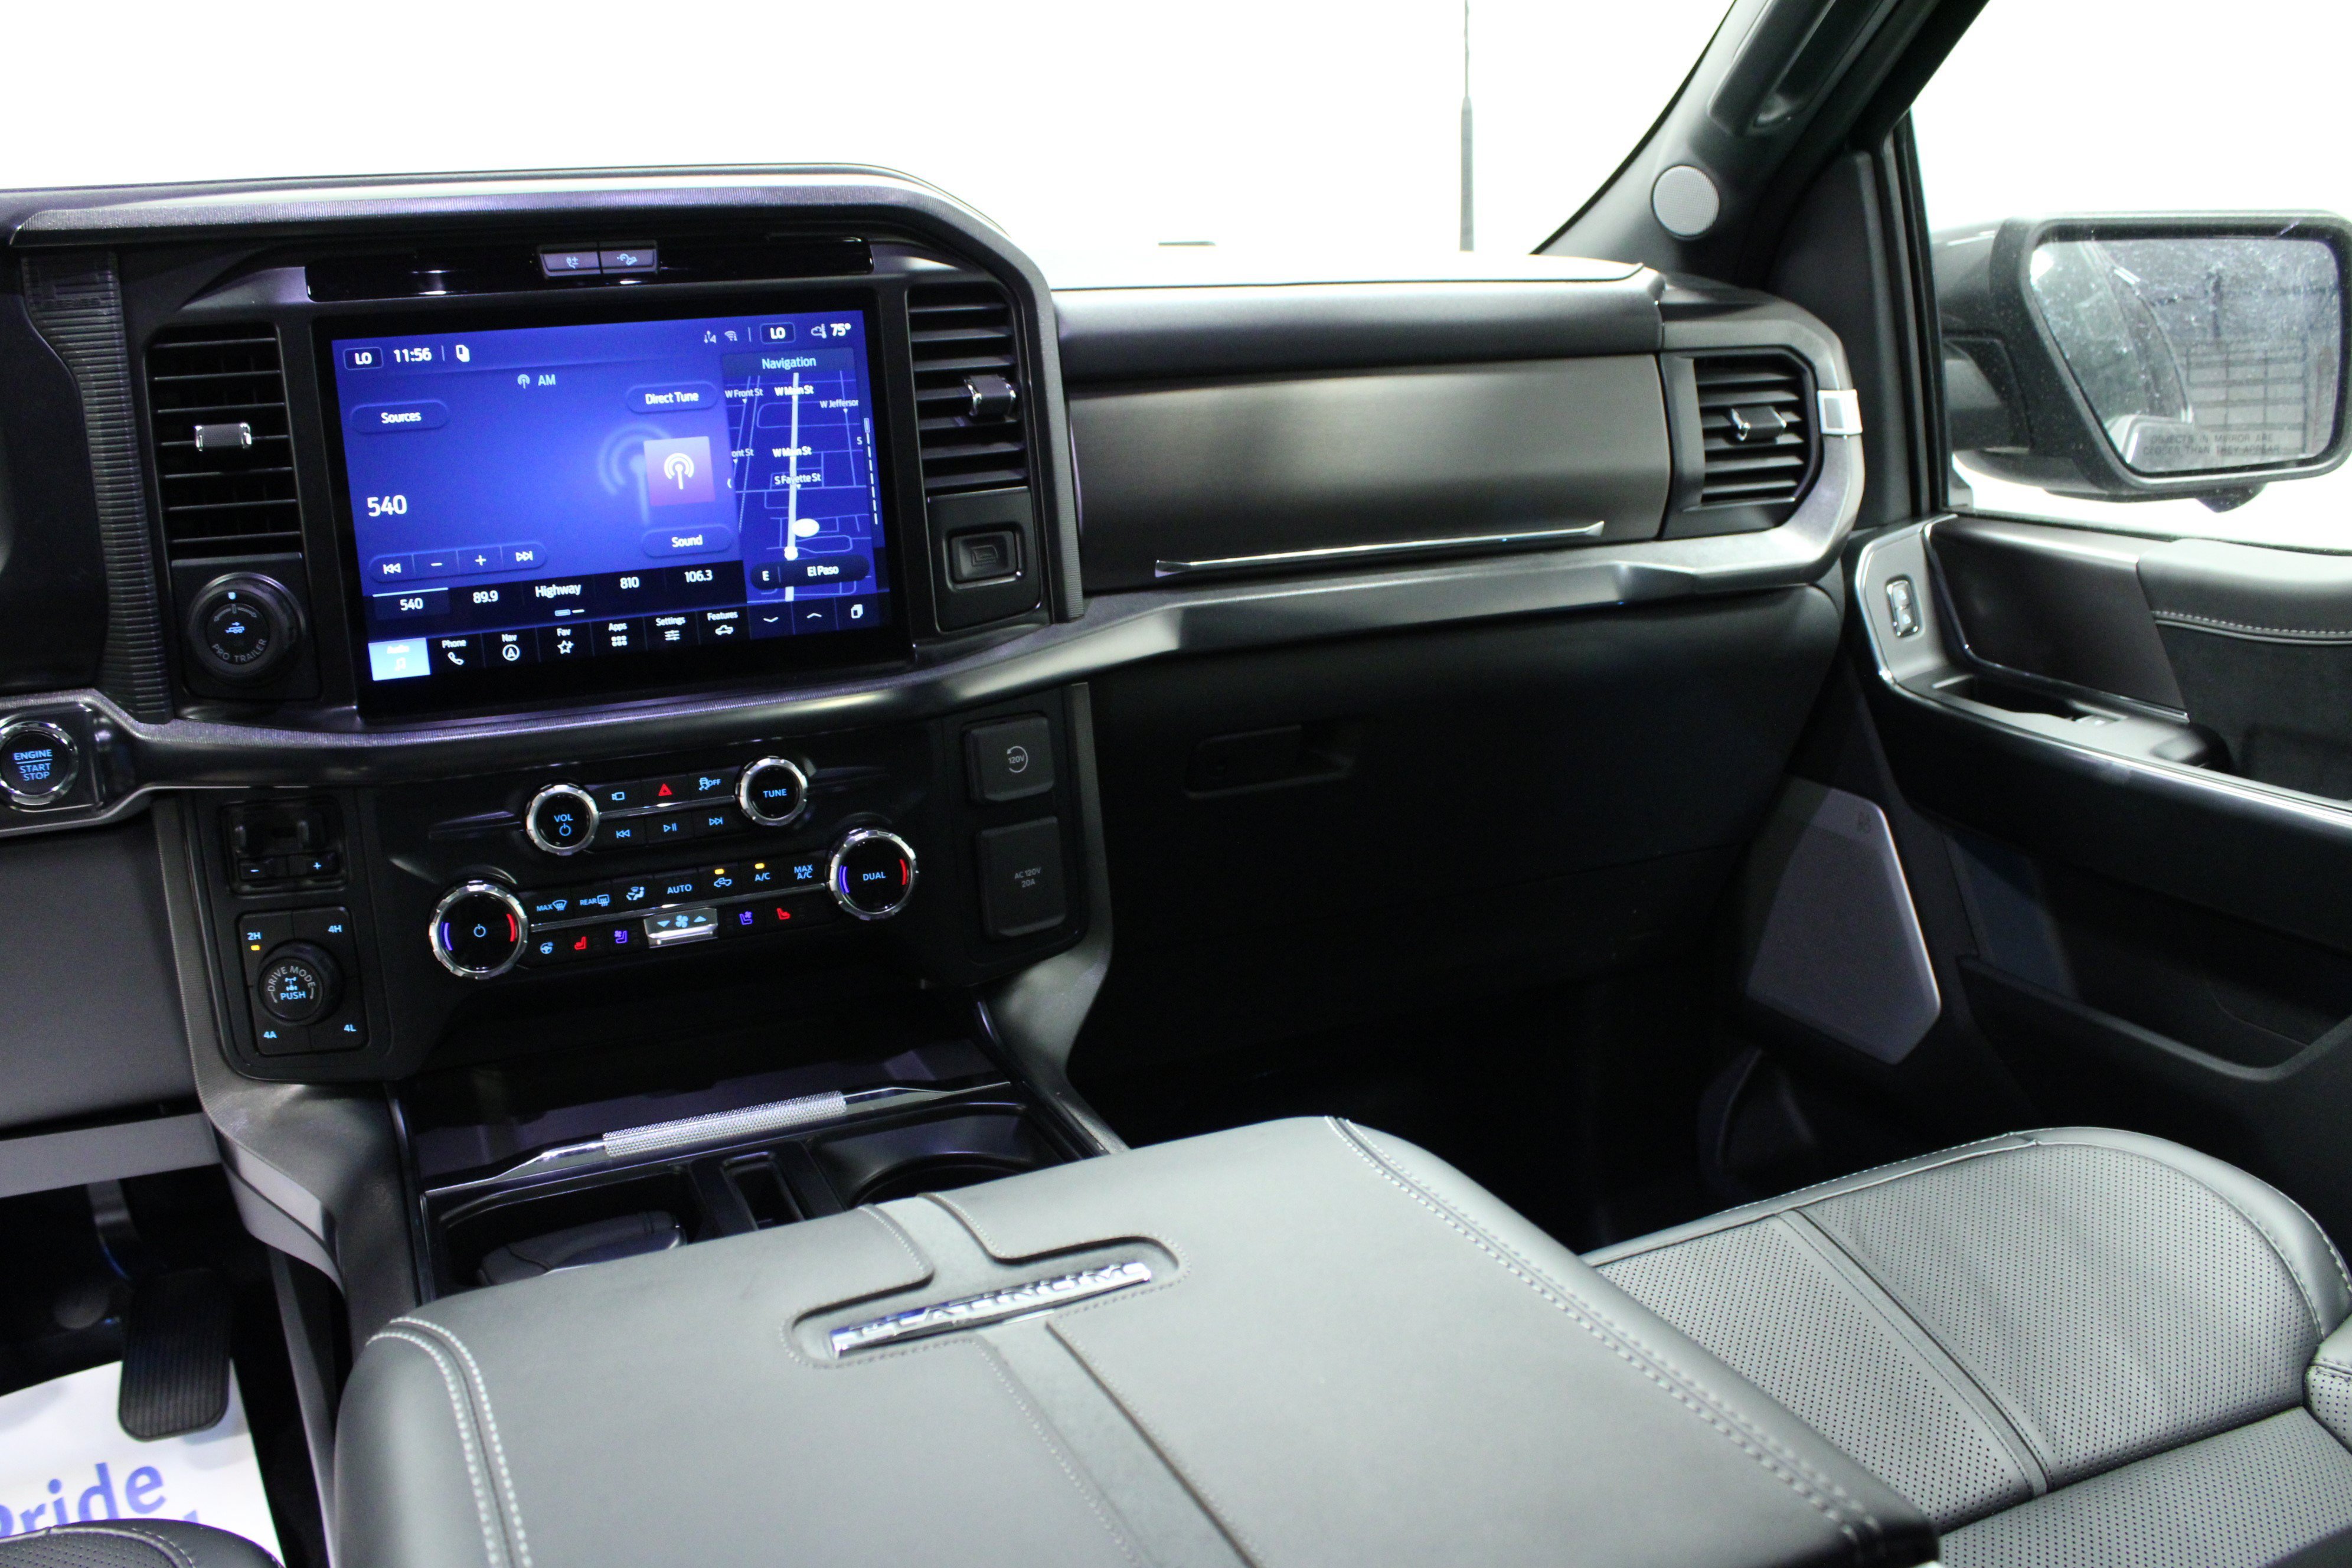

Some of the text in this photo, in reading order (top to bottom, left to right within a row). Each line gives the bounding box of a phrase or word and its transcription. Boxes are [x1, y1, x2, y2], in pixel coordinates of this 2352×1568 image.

[770, 327, 786, 339] LO
[355, 352, 373, 365] LO
[394, 348, 432, 362] 11:56
[762, 357, 816, 370] Navigation
[538, 374, 556, 386] AM
[724, 388, 763, 398] W Front St
[804, 385, 814, 394] St
[645, 391, 699, 404] Direct Tune
[819, 400, 828, 409] W
[381, 412, 422, 424] Sources
[744, 448, 754, 457] St
[802, 446, 812, 455] St
[781, 473, 811, 485] Fayette
[811, 473, 821, 482] St
[367, 495, 407, 517] 540
[672, 534, 703, 547] Sound
[685, 569, 713, 583] 106.3
[762, 571, 770, 581] E
[807, 566, 839, 577] El Paso
[620, 576, 639, 589] 810
[535, 583, 582, 598] Highway
[473, 590, 499, 604] 89.9
[400, 597, 424, 610] 540
[655, 615, 685, 626] Settings
[707, 611, 739, 621] Features
[557, 628, 571, 636] Fav
[608, 622, 628, 632] Apps
[502, 634, 517, 642] Nav
[442, 639, 466, 649] Phone
[212, 639, 267, 662] PRO TRAILER
[14, 749, 53, 761] ENGINE
[1008, 755, 1025, 764] 120V
[19, 763, 51, 773] START
[24, 772, 50, 781] STOP
[763, 789, 787, 798] TUNE
[554, 814, 573, 822] VOL
[794, 864, 813, 874] MAX
[1014, 867, 1041, 880] AC 120V
[754, 872, 770, 881] A/C
[797, 871, 812, 880] A/C
[863, 871, 886, 881] DUAL
[1021, 878, 1035, 888] 20A
[667, 884, 692, 894] AUTO
[328, 925, 342, 933] 4H
[247, 932, 262, 940] 2H
[267, 965, 316, 992] DRIVE MODE
[280, 991, 306, 1001] PUSH
[344, 1024, 357, 1033] 4L
[263, 1031, 277, 1039] 4A
